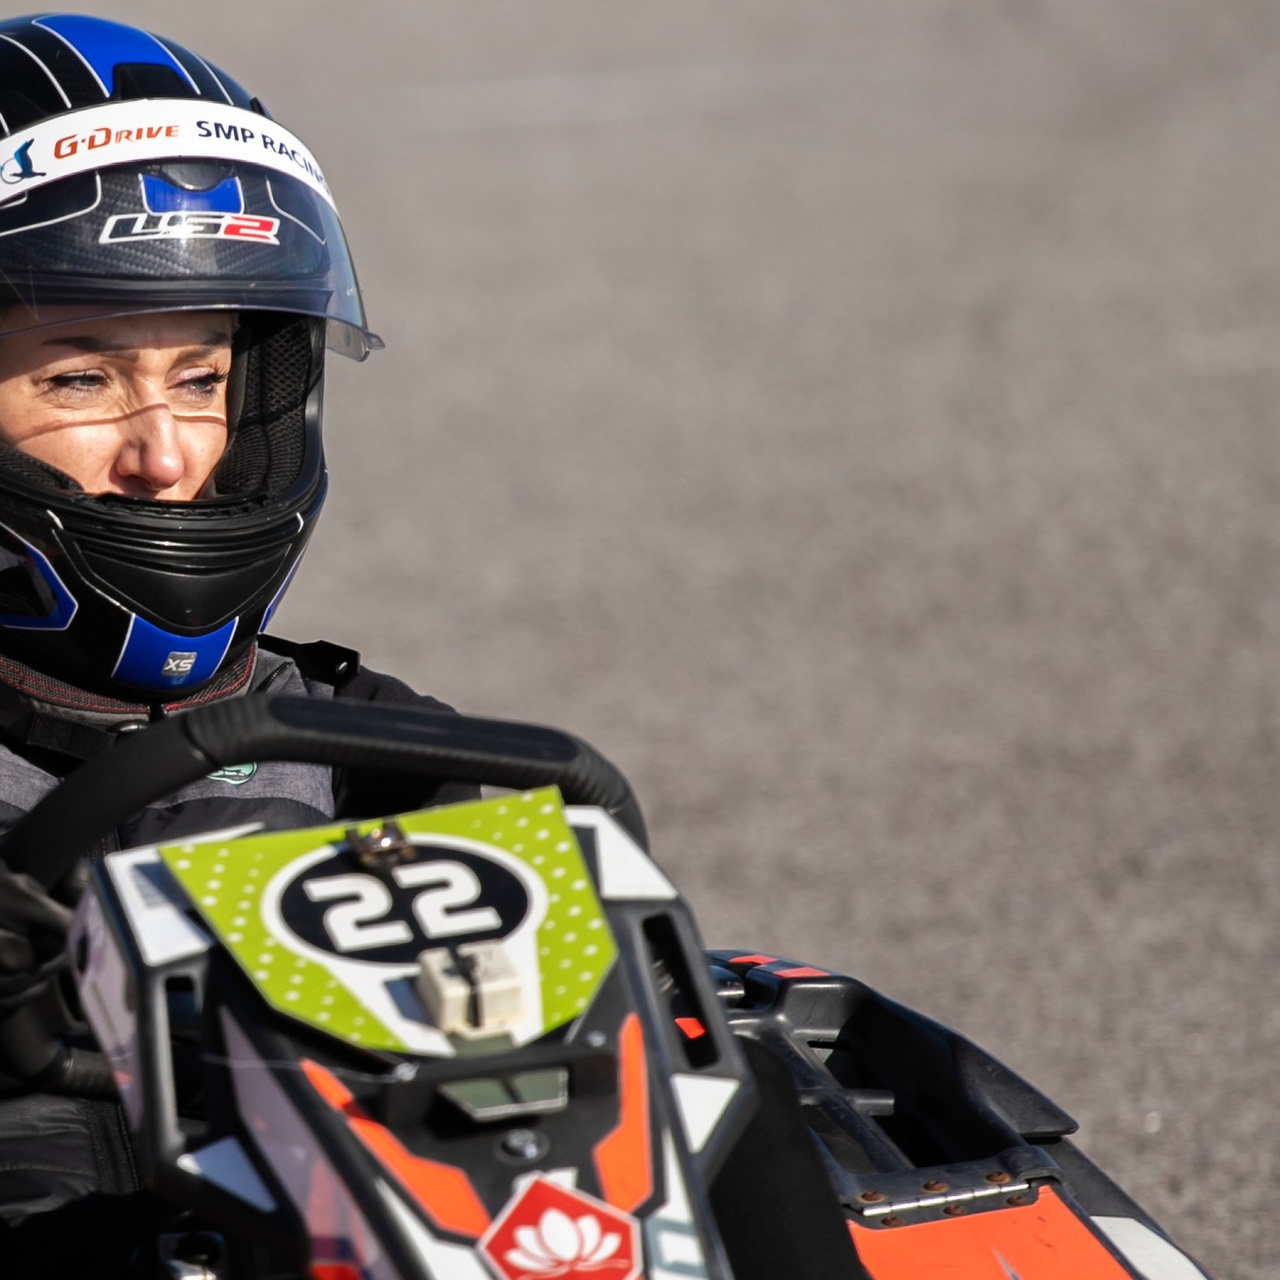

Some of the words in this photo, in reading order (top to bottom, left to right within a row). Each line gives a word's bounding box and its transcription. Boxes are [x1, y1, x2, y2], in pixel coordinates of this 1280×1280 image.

[196, 121, 255, 143] SMP
[99, 211, 280, 245] LS2
[163, 659, 195, 671] XS
[303, 860, 503, 953] 22
